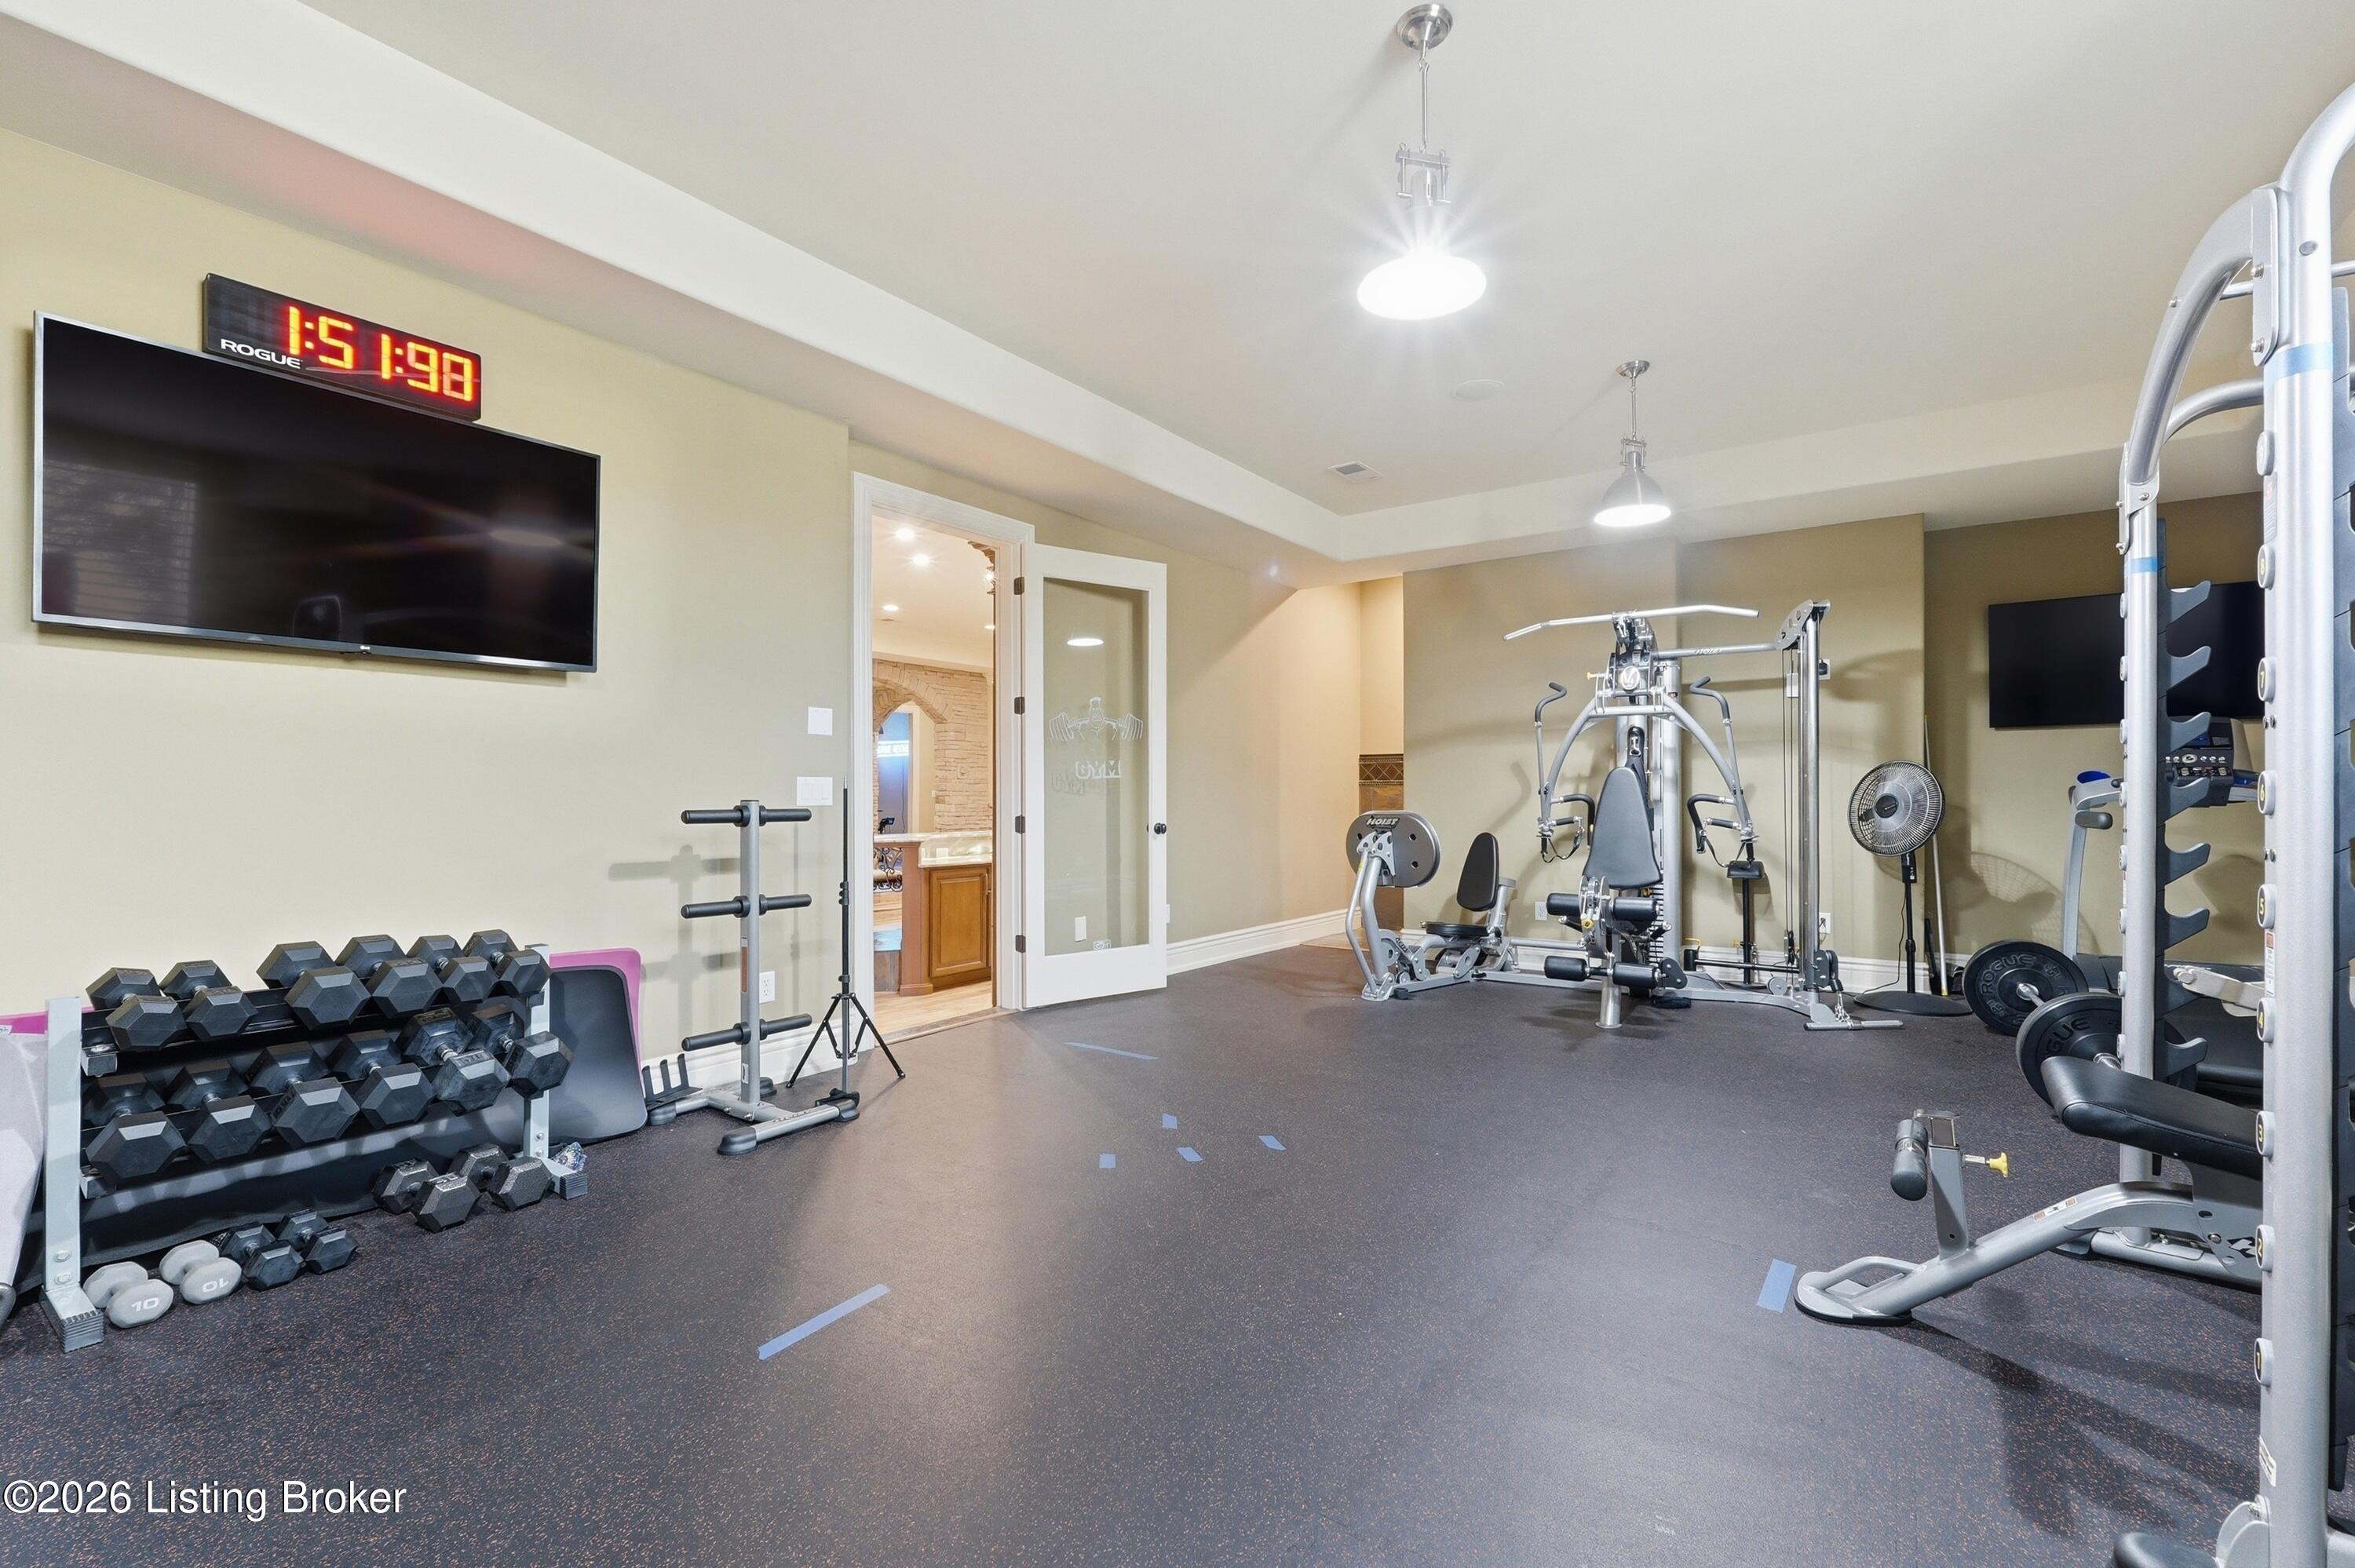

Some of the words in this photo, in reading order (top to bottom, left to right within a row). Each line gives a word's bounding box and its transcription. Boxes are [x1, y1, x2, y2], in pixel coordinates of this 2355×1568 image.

[220, 338, 301, 370] ROGUE
[1075, 758, 1121, 780] GYM
[202, 1278, 230, 1293] 10
[131, 1296, 159, 1312] 10
